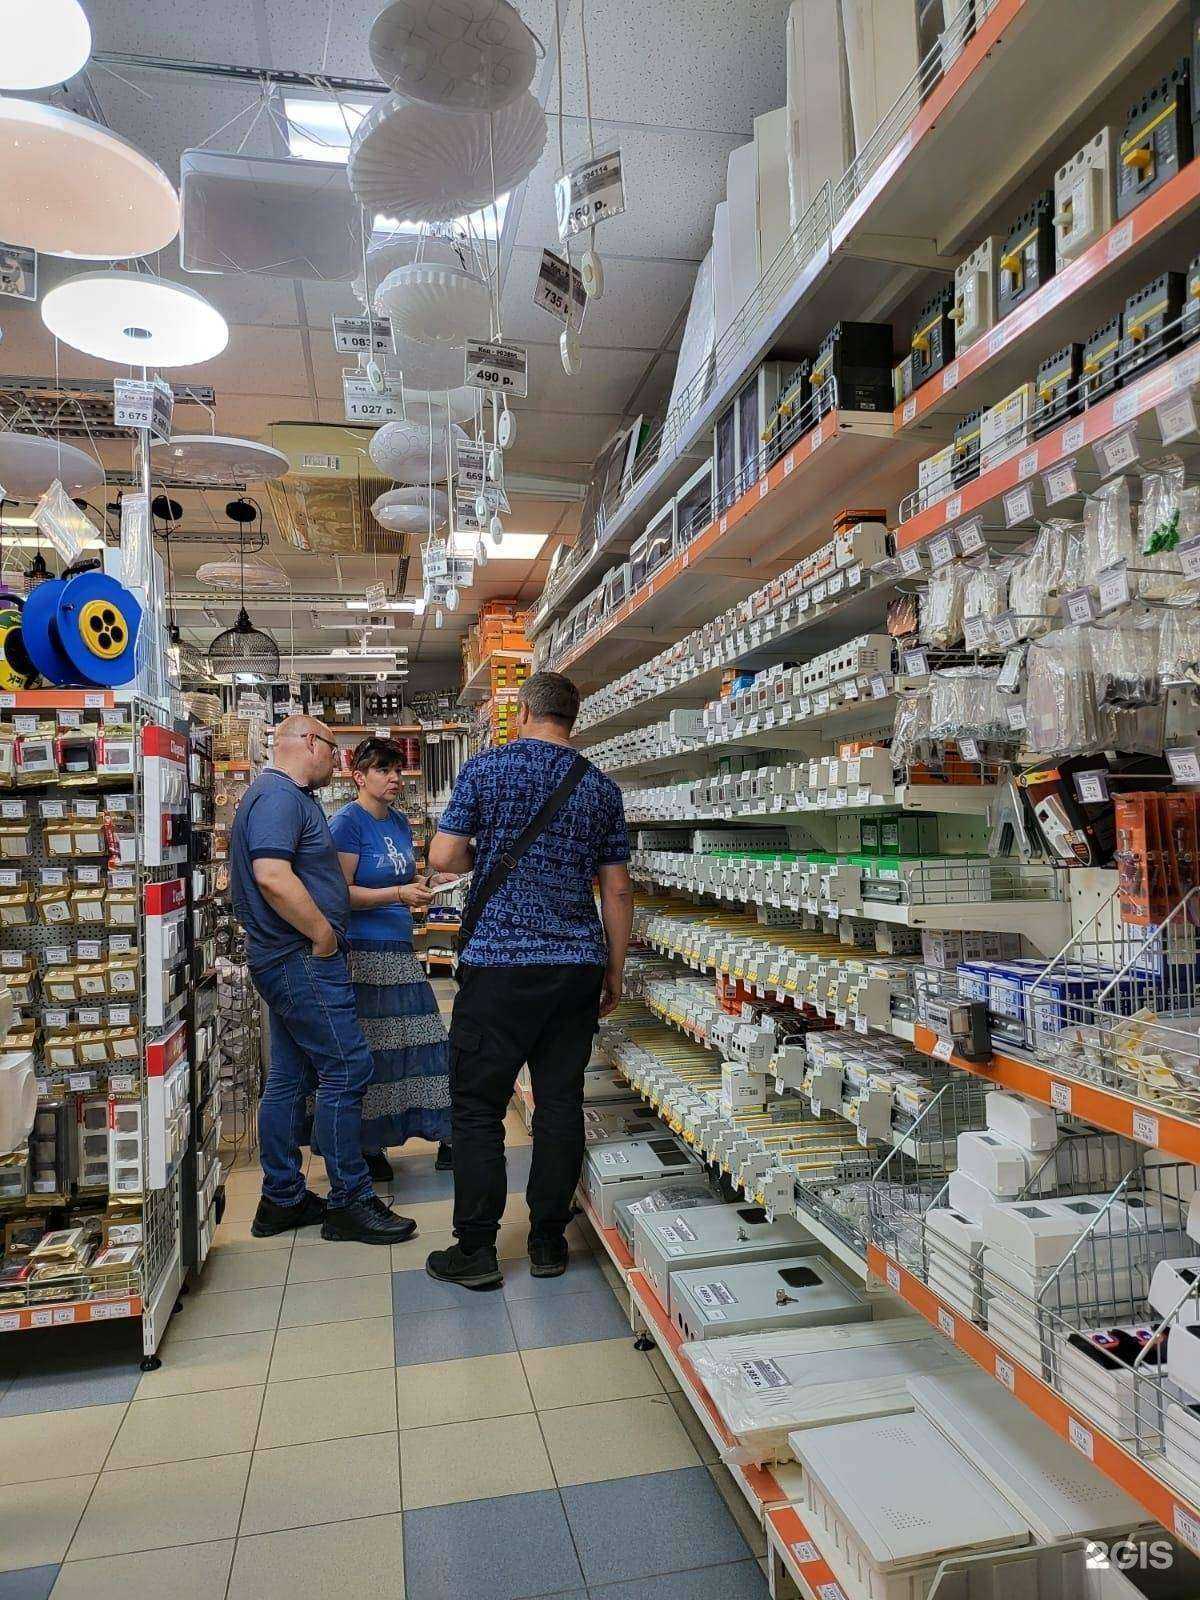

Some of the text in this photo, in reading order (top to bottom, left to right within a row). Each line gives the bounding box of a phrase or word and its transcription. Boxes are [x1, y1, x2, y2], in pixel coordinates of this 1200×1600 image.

[544, 287, 563, 308] 735
[476, 370, 499, 382] 490
[361, 405, 382, 413] 027
[128, 412, 148, 421] 675
